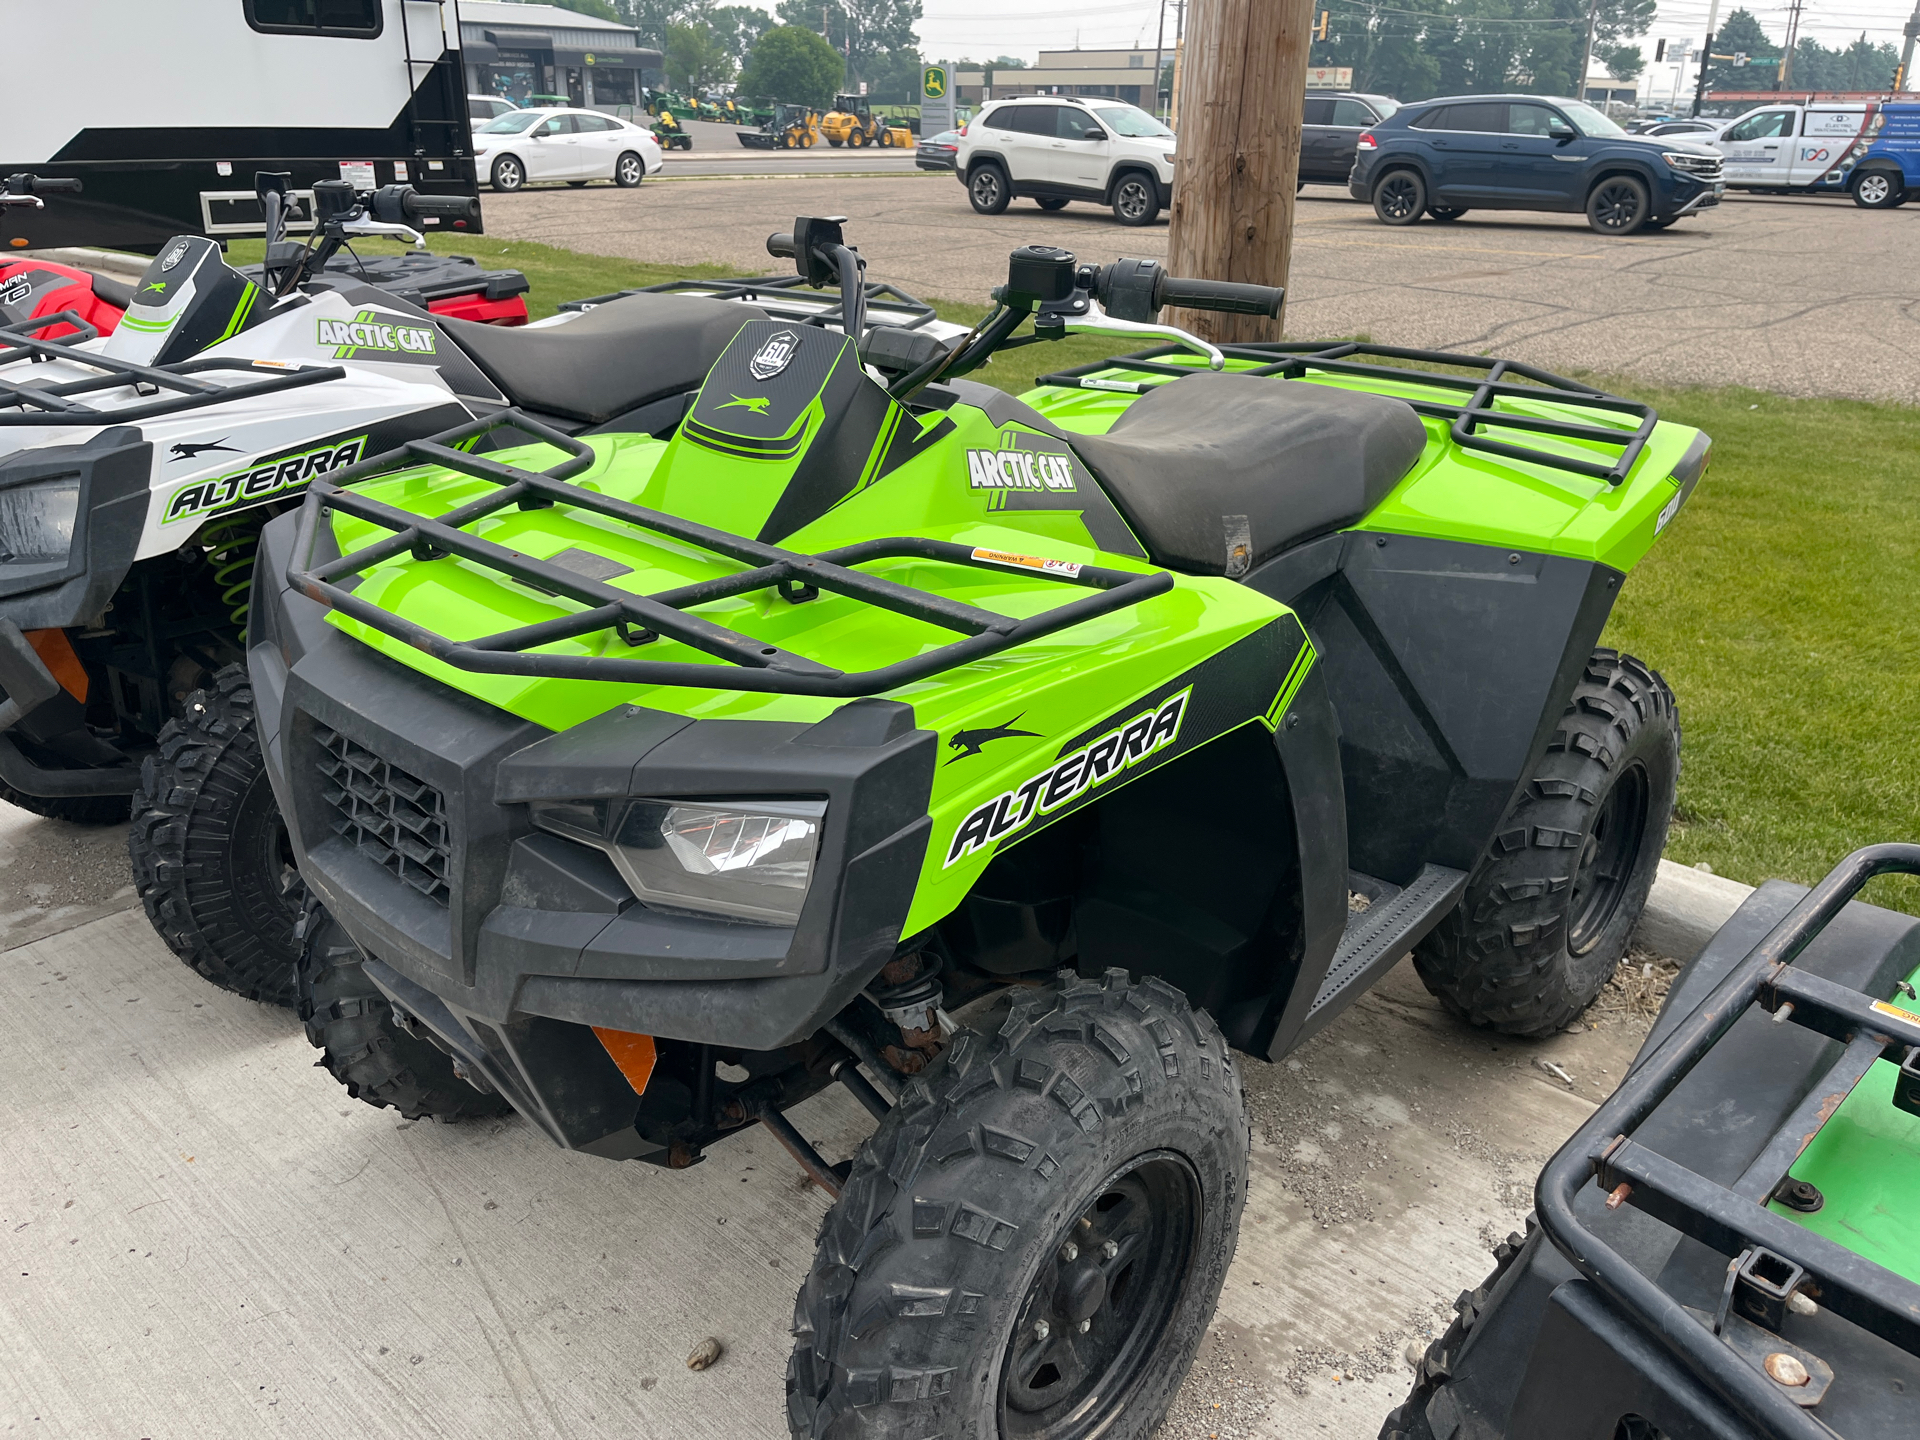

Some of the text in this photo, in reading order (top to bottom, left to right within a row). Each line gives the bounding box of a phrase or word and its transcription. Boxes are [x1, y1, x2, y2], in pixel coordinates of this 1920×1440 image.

[319, 319, 433, 351] ARCTIC CAT
[763, 341, 791, 361] 60
[169, 441, 362, 517] ALTERRA
[966, 450, 1074, 488] ARCTIC CAT
[1653, 489, 1682, 537] 600
[988, 552, 1018, 563] WARNING
[945, 692, 1188, 866] ALTERRA
